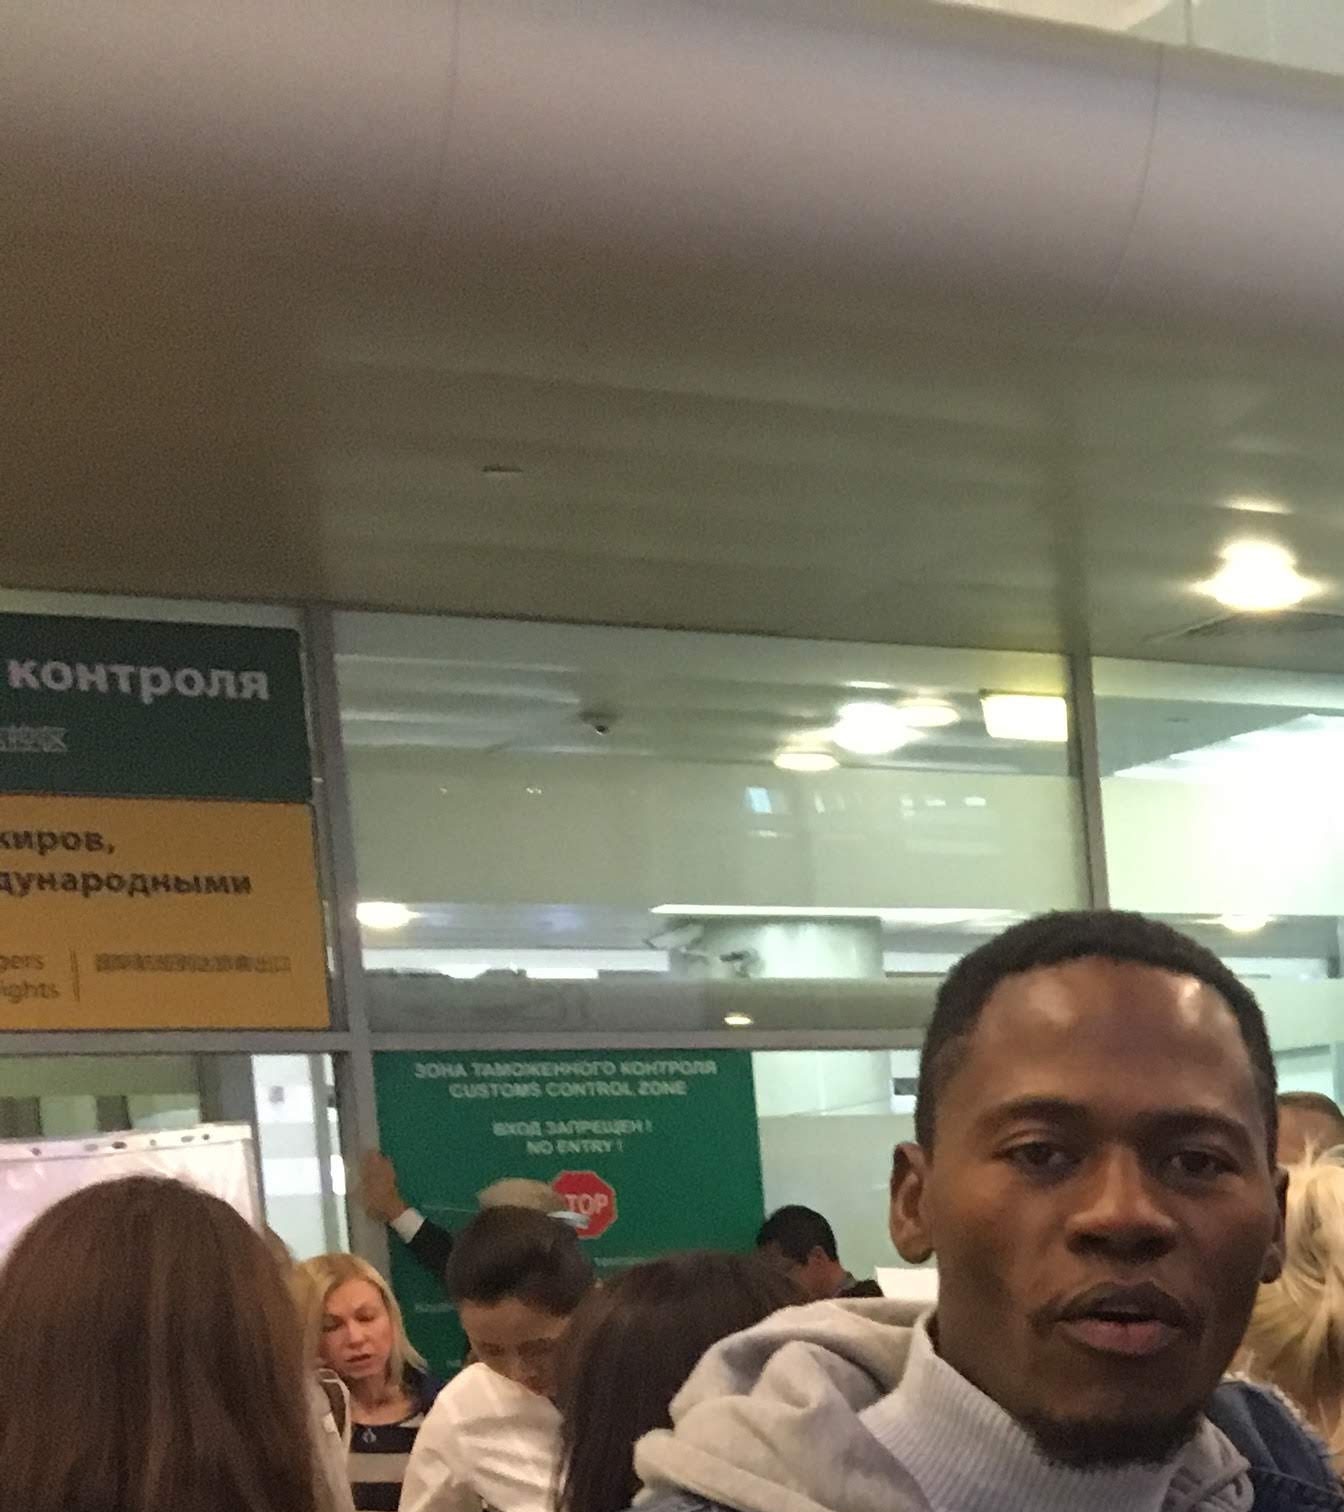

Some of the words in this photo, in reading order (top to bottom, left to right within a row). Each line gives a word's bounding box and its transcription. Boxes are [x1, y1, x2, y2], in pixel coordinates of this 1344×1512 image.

[8, 659, 270, 705] контроля
[414, 1062, 468, 1078] ЗОНА
[472, 1060, 616, 1077] ТАМОЖЕННОГО
[620, 1059, 718, 1076] КОНТРОЛЯ
[450, 1081, 542, 1098] CUSTOMS
[545, 1080, 635, 1097] CONTROL
[638, 1080, 688, 1096] ZONE
[493, 1121, 542, 1136] ВХОД
[527, 1140, 554, 1155] NO
[564, 1193, 609, 1216] TOP
